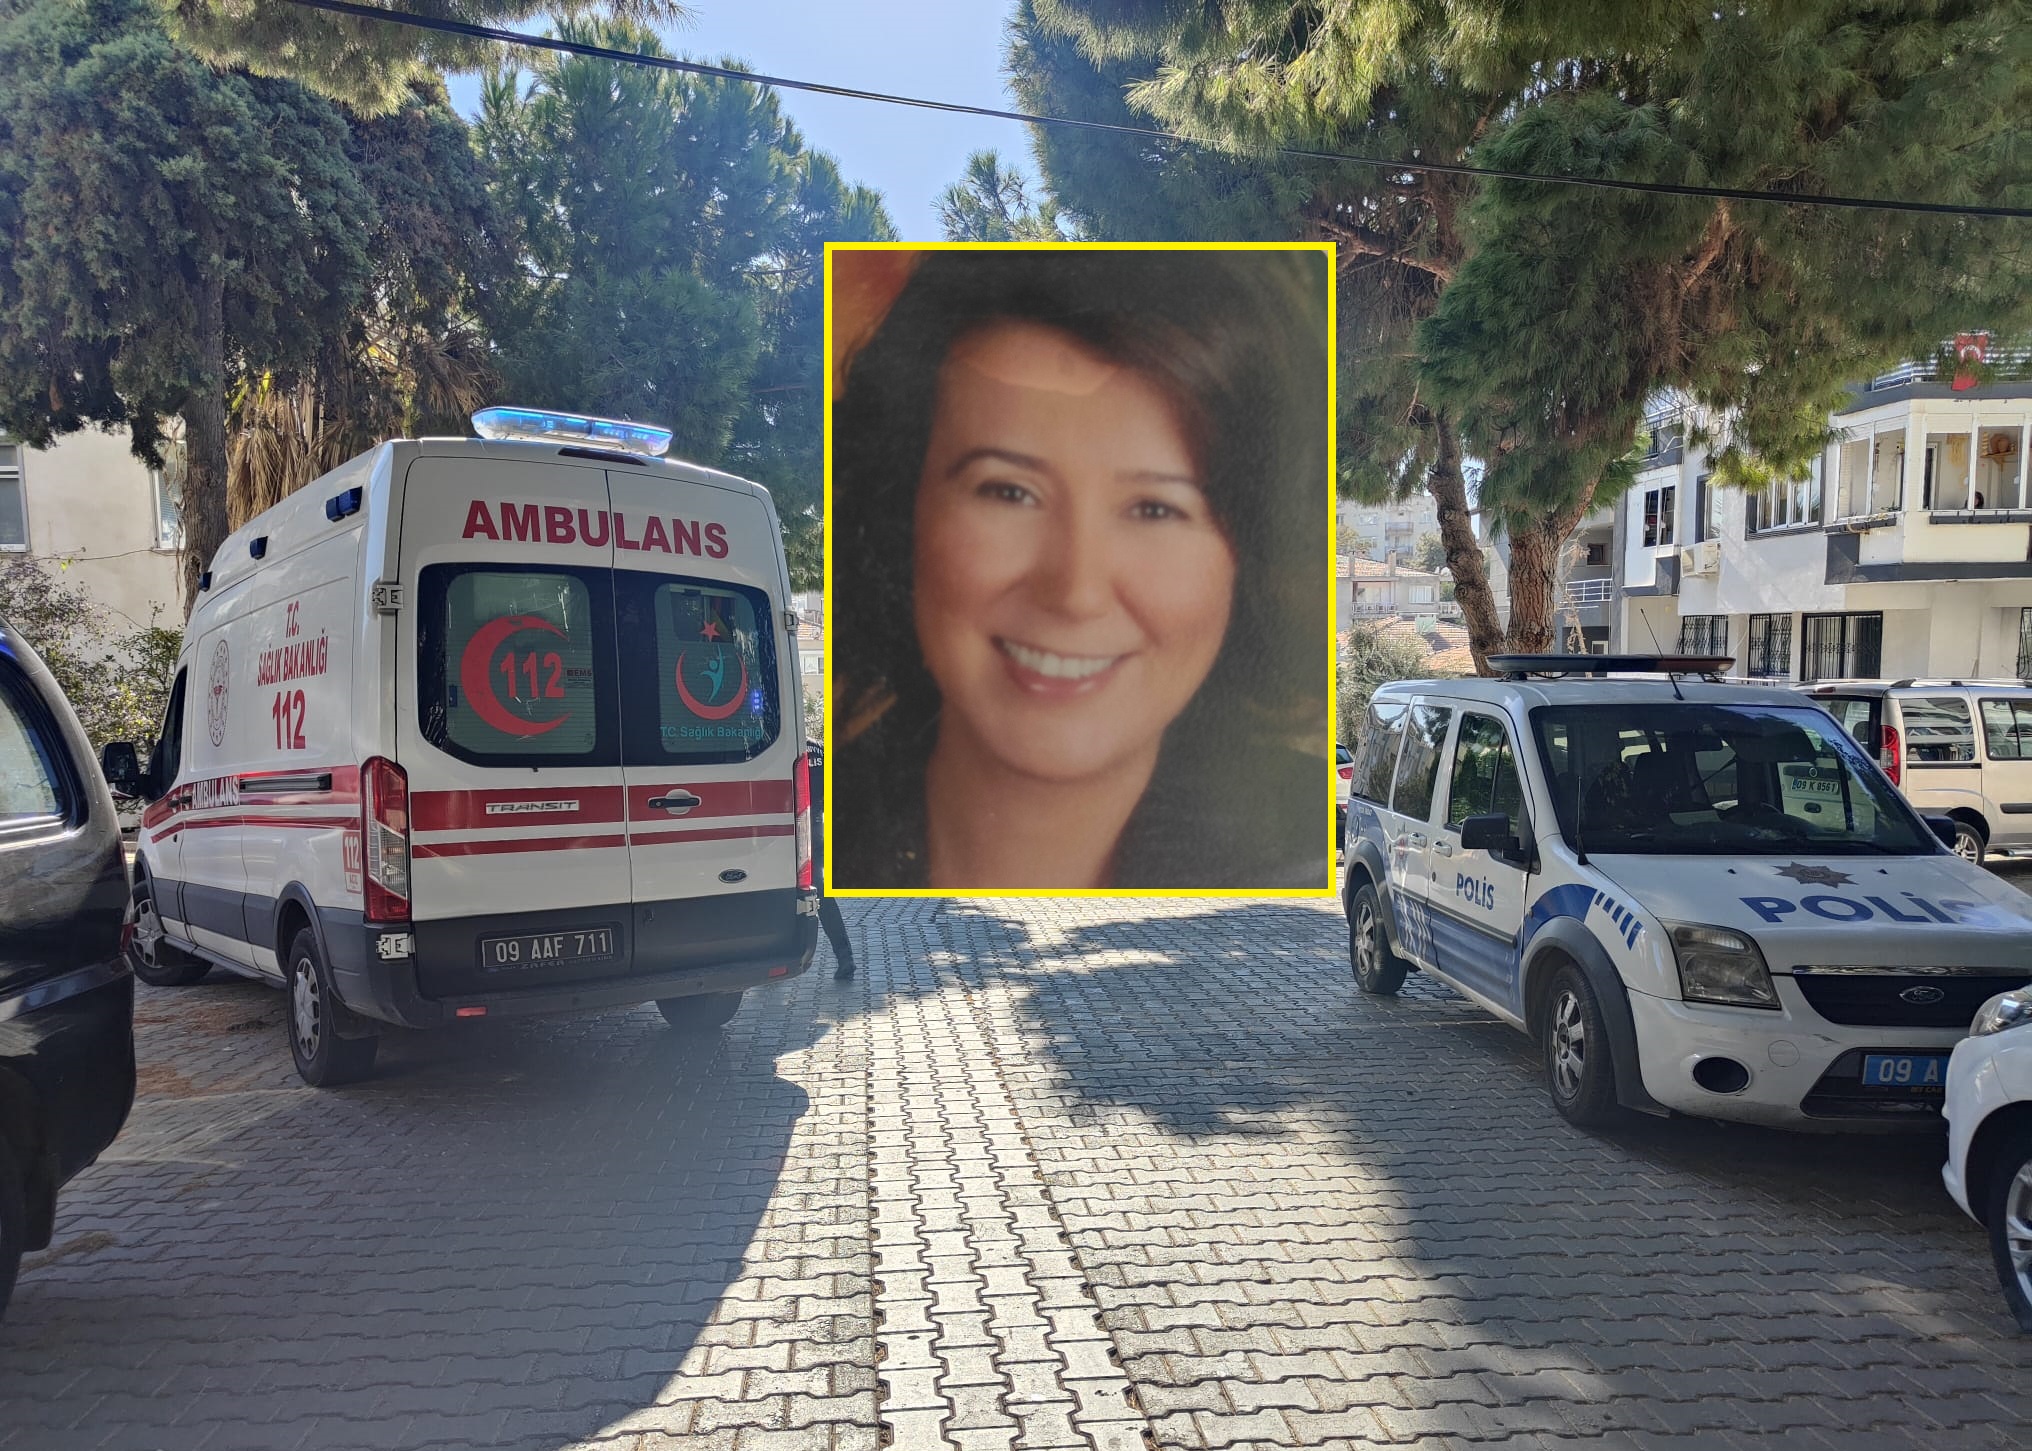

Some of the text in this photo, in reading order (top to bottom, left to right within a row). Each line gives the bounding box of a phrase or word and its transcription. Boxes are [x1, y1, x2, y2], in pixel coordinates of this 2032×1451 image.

[462, 500, 729, 559] AMBULANS
[286, 601, 300, 638] T.C.
[500, 652, 565, 698] 112
[272, 689, 306, 750] 112
[680, 726, 714, 741] Sağlık
[192, 775, 240, 809] AMBULANS
[1797, 780, 1807, 790] 09
[1809, 781, 1816, 790] K
[486, 801, 577, 813] TRANSIT
[344, 836, 360, 870] 112
[1455, 872, 1495, 911] POLİS
[495, 932, 607, 963] 09 AAF 711
[1879, 1059, 1912, 1082] 09
